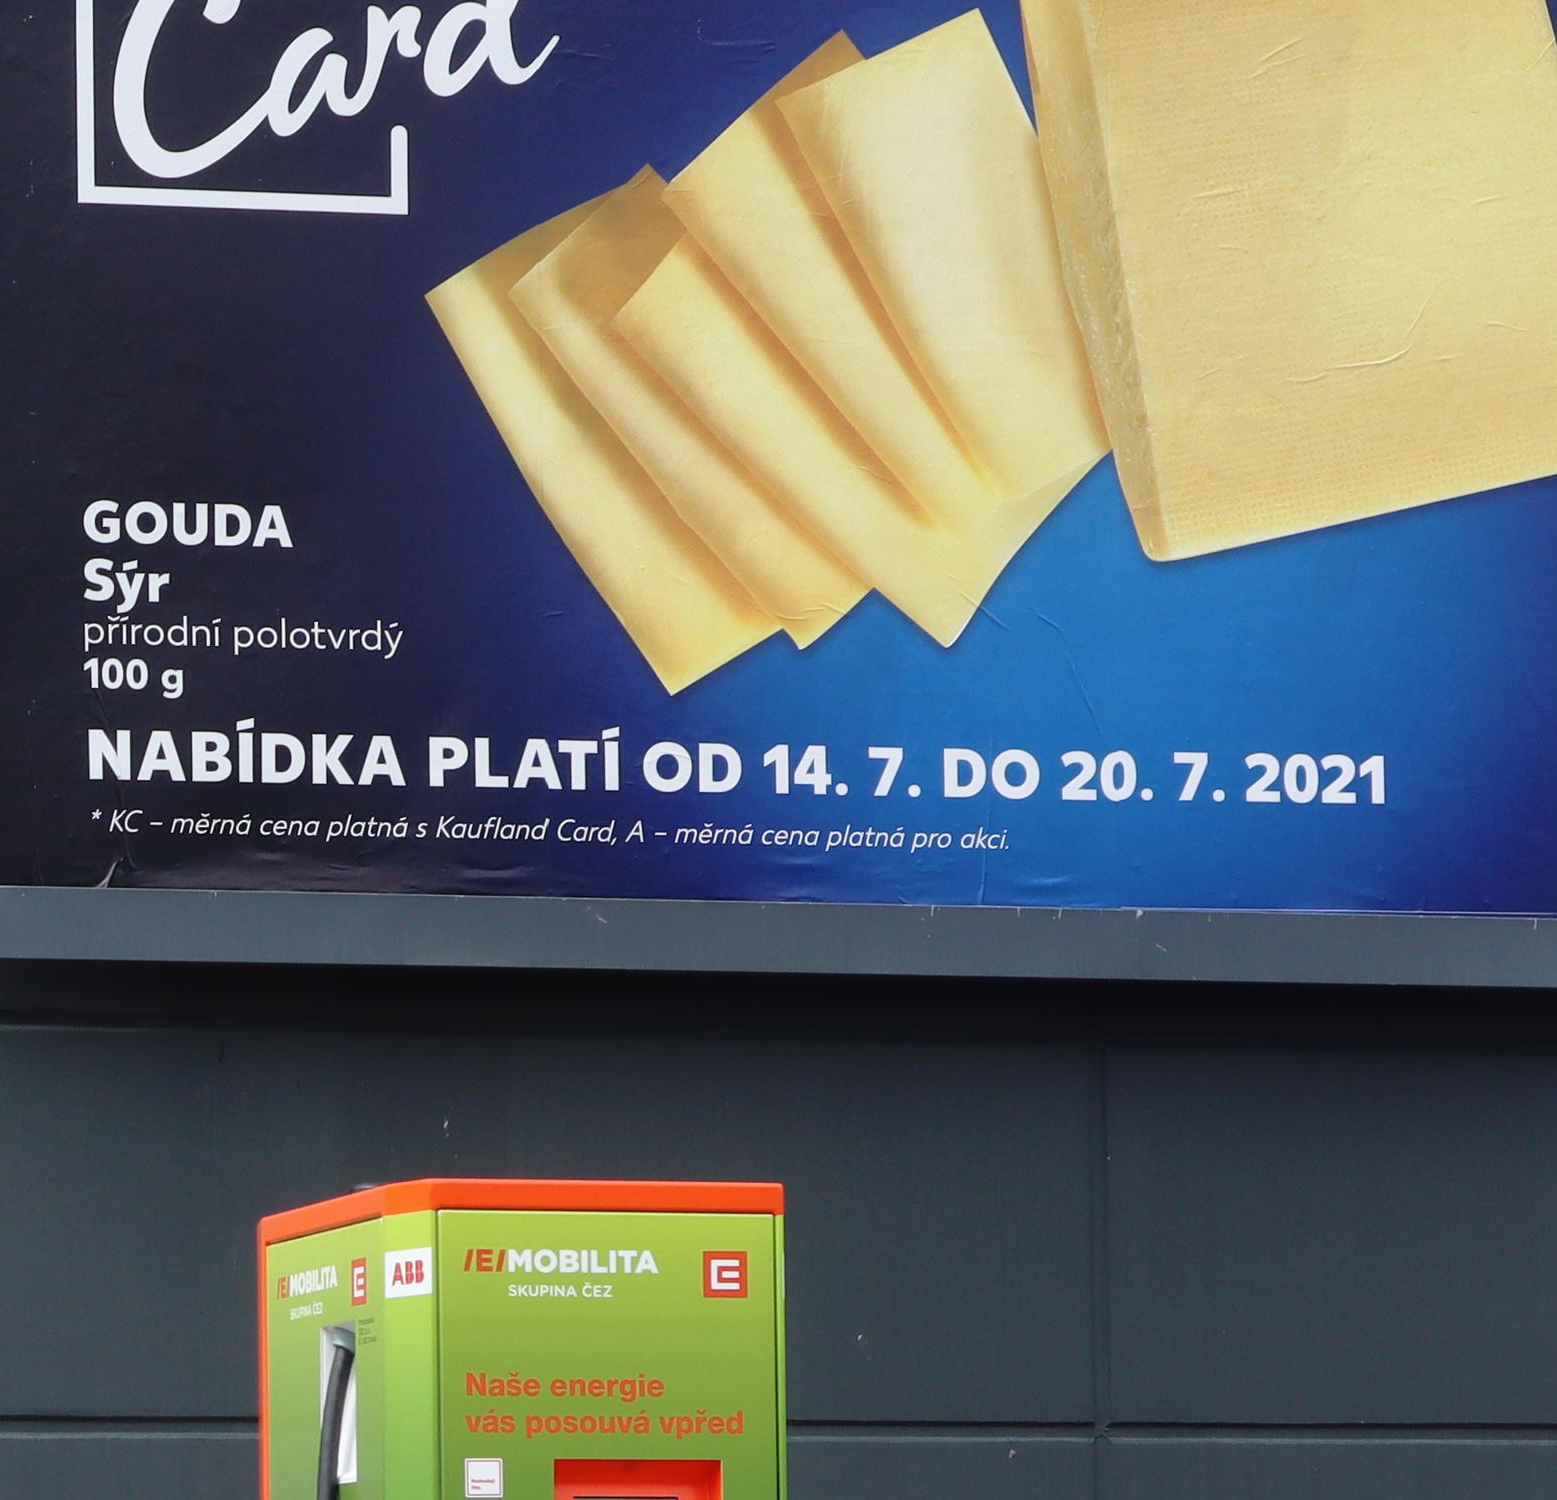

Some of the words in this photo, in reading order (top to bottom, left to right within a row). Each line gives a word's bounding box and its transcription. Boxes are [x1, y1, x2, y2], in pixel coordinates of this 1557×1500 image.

[113, 0, 561, 179] Card
[83, 500, 294, 548] GOUDA
[83, 558, 170, 614] Sýr
[84, 615, 222, 652] přírodní
[233, 617, 404, 660] polotvrdý
[83, 657, 149, 690] 100
[161, 667, 184, 699] g
[87, 717, 407, 787] NABÍDKA
[428, 726, 621, 792] PLATÍ
[642, 741, 743, 794] OD
[762, 743, 849, 796] 14.
[868, 746, 922, 798] 7.
[943, 748, 1041, 801] DO
[1061, 750, 1155, 803] 20.
[1173, 752, 1226, 803] 7.
[1245, 752, 1387, 806] 2021
[109, 809, 144, 834] KC
[171, 813, 252, 836] měrná
[259, 819, 321, 837] cena
[326, 815, 409, 843] platná
[416, 822, 428, 839] s
[436, 816, 551, 842] Kaufland
[557, 819, 618, 846] Card,
[625, 820, 645, 844] A
[675, 822, 754, 847] měrná
[761, 828, 821, 847] cena
[826, 825, 906, 853] platná
[910, 831, 953, 855] pro
[960, 827, 1011, 852] akci.
[392, 1259, 426, 1287] ABB
[463, 1248, 660, 1274] /E/MOBILITA
[507, 1283, 578, 1298] SKUPINA
[581, 1281, 614, 1298] ČEZ
[465, 1371, 541, 1397] Naše
[549, 1372, 666, 1403] energie
[464, 1408, 517, 1434] vás
[524, 1409, 651, 1440] posouvá
[658, 1409, 745, 1440] vpřed
